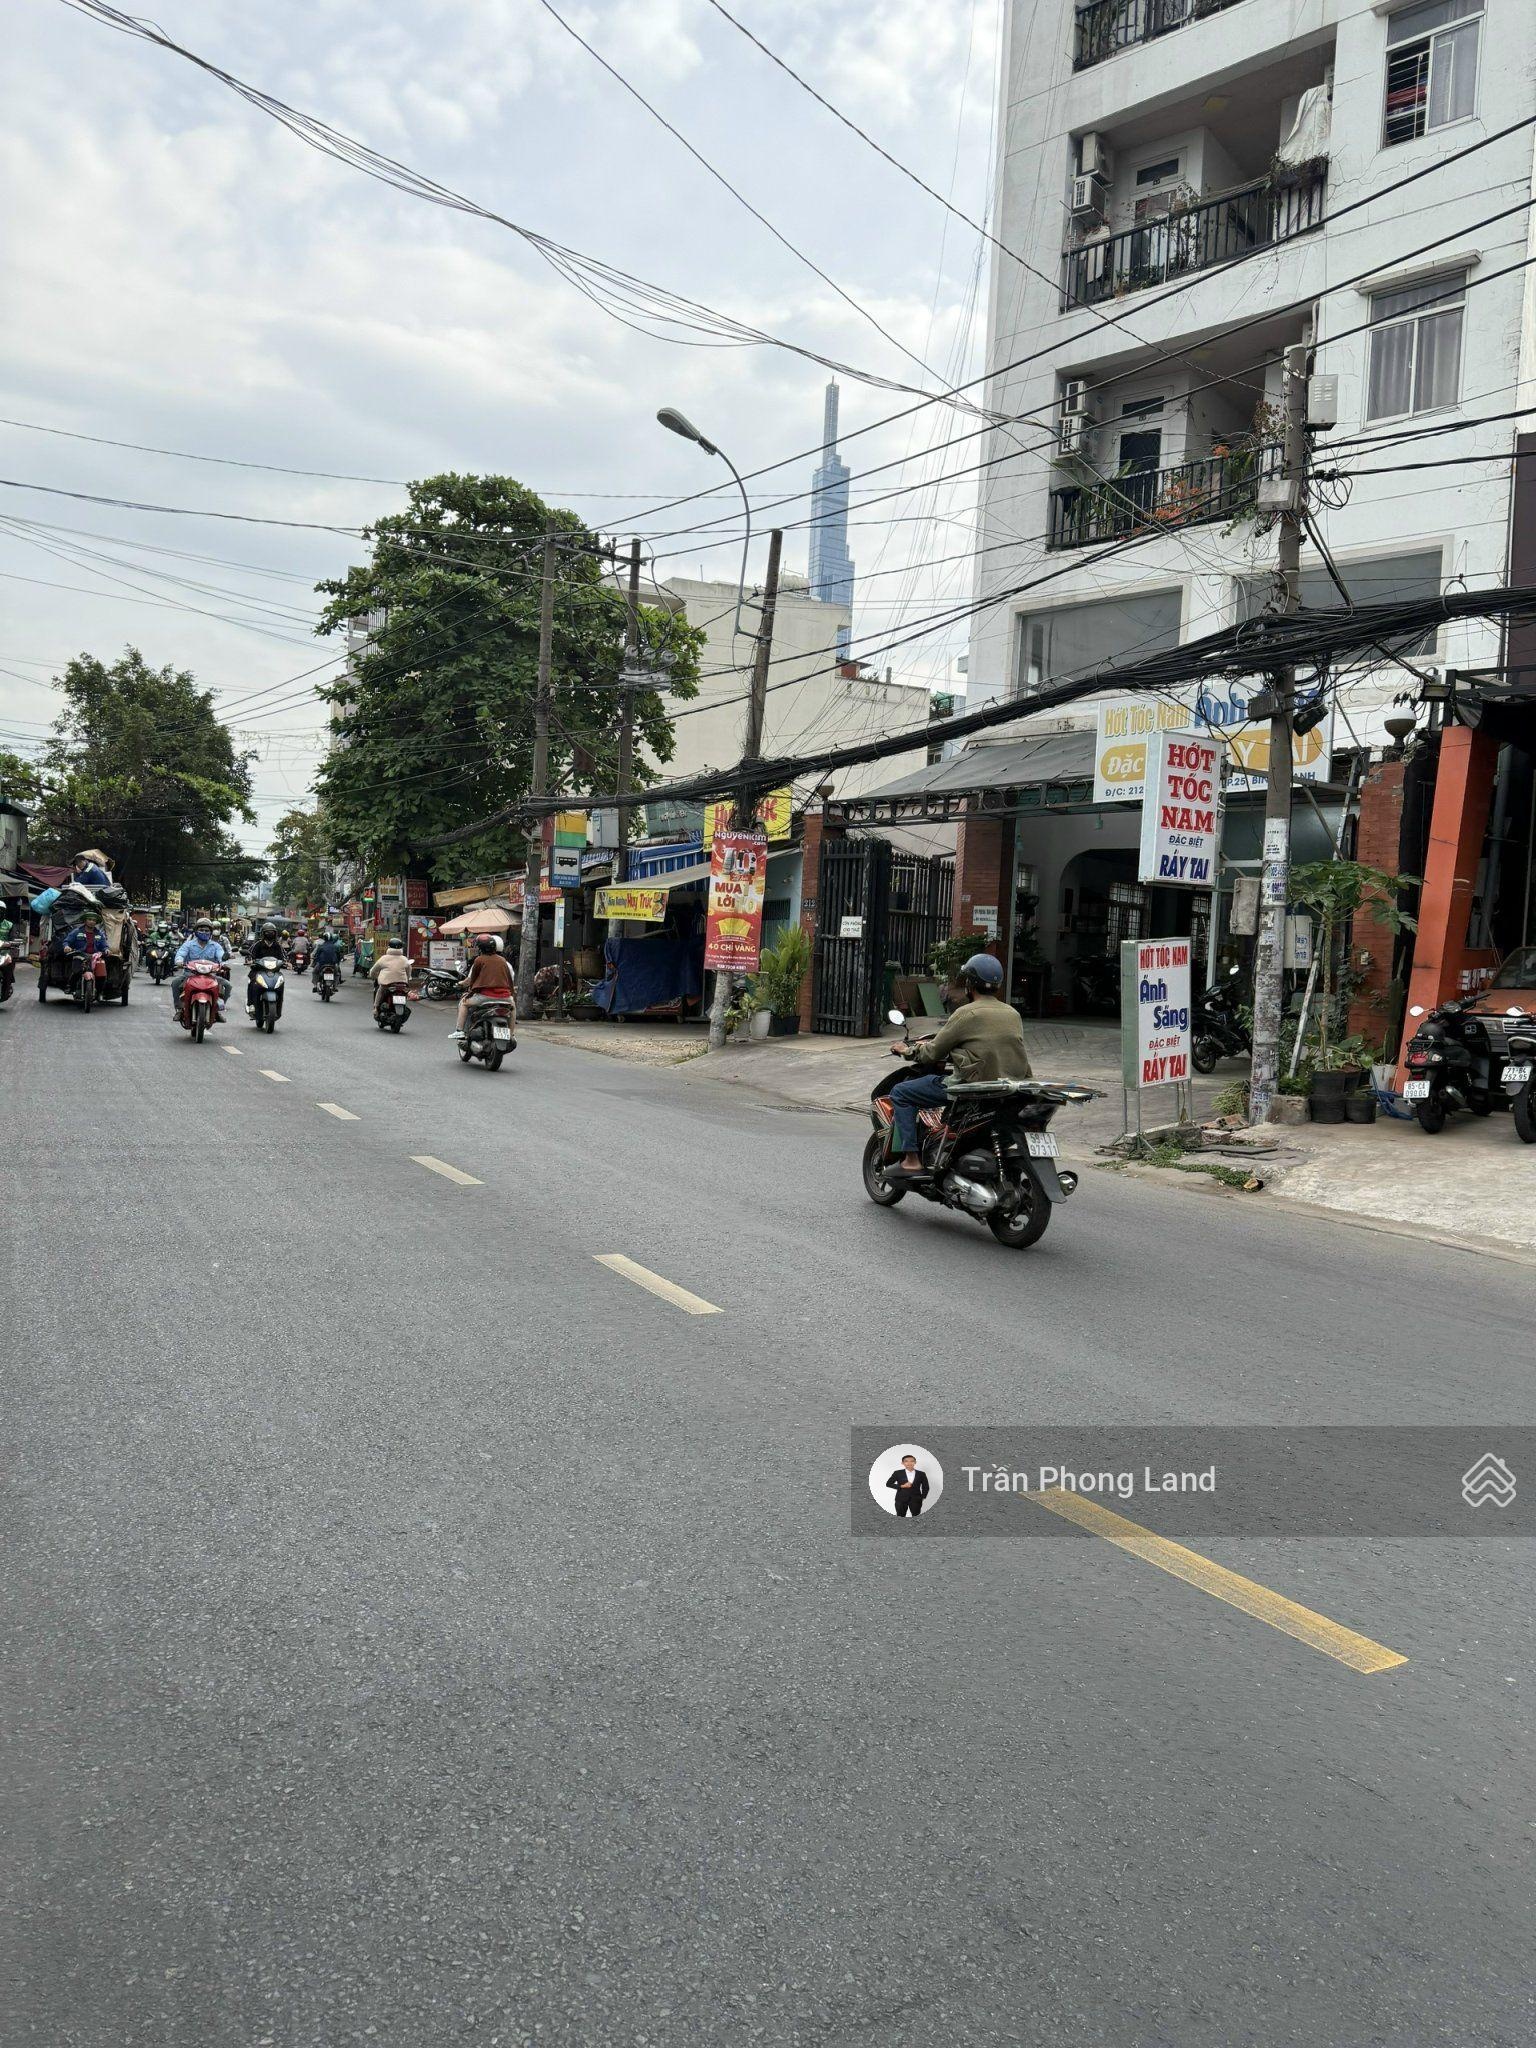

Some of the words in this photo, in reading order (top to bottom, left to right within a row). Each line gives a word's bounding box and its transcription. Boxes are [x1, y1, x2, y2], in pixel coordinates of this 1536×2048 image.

[1104, 705, 1128, 738] Hớt
[1130, 704, 1153, 735] Tóc
[1157, 701, 1190, 733] Nam
[1106, 754, 1144, 780] Đặc
[1167, 742, 1216, 773] HỚT
[1168, 773, 1213, 804] TÓC
[1160, 805, 1215, 834] NAM
[1168, 834, 1187, 845] ĐẶC
[1188, 836, 1204, 848] BIỆT
[1159, 849, 1188, 880] RÁY
[1189, 857, 1210, 880] TAI
[715, 882, 743, 895] MUA
[717, 894, 736, 908] LỜI
[708, 942, 719, 950] 40
[735, 943, 756, 953] VÀNG
[1140, 945, 1154, 969] HỚT
[1156, 944, 1170, 968] TÓC
[1172, 946, 1188, 967] NAM
[1140, 975, 1168, 1004] Ánh
[1153, 1005, 1189, 1032] Sáng
[1149, 1038, 1165, 1050] ĐẶC
[1166, 1036, 1181, 1048] BIỆT
[1142, 1052, 1168, 1084] RÁY
[1169, 1054, 1188, 1079] TAI
